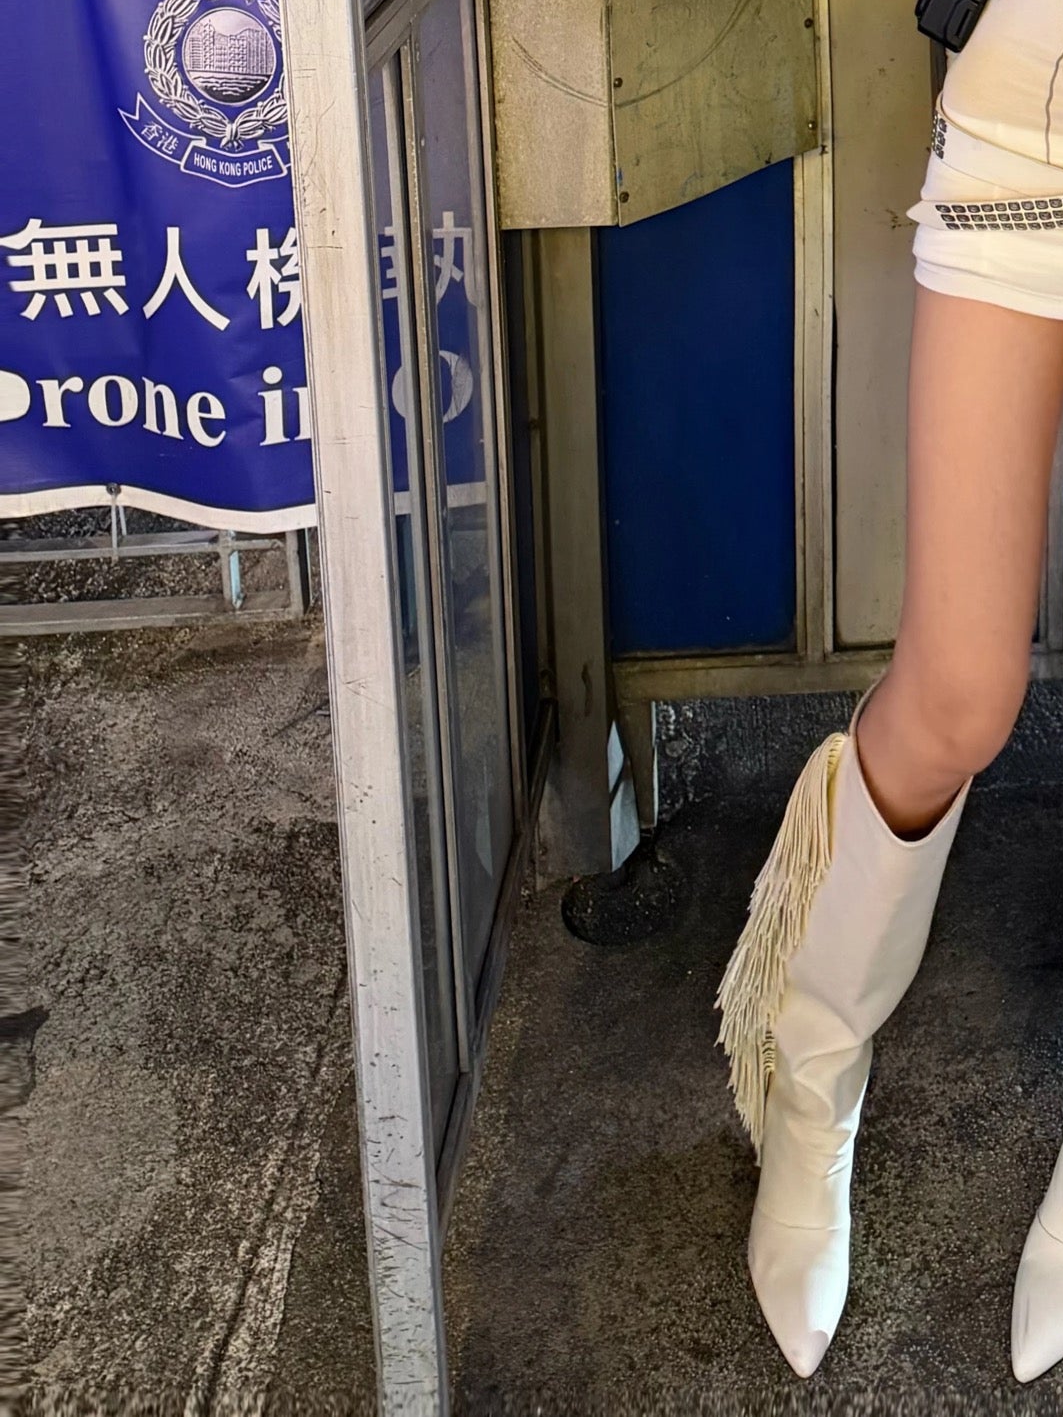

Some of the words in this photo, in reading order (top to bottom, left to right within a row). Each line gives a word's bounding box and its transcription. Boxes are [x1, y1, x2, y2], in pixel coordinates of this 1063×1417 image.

[140, 120, 180, 155] 香港
[193, 152, 218, 173] HONG
[218, 159, 242, 177] KONG
[243, 154, 273, 175] POLICE
